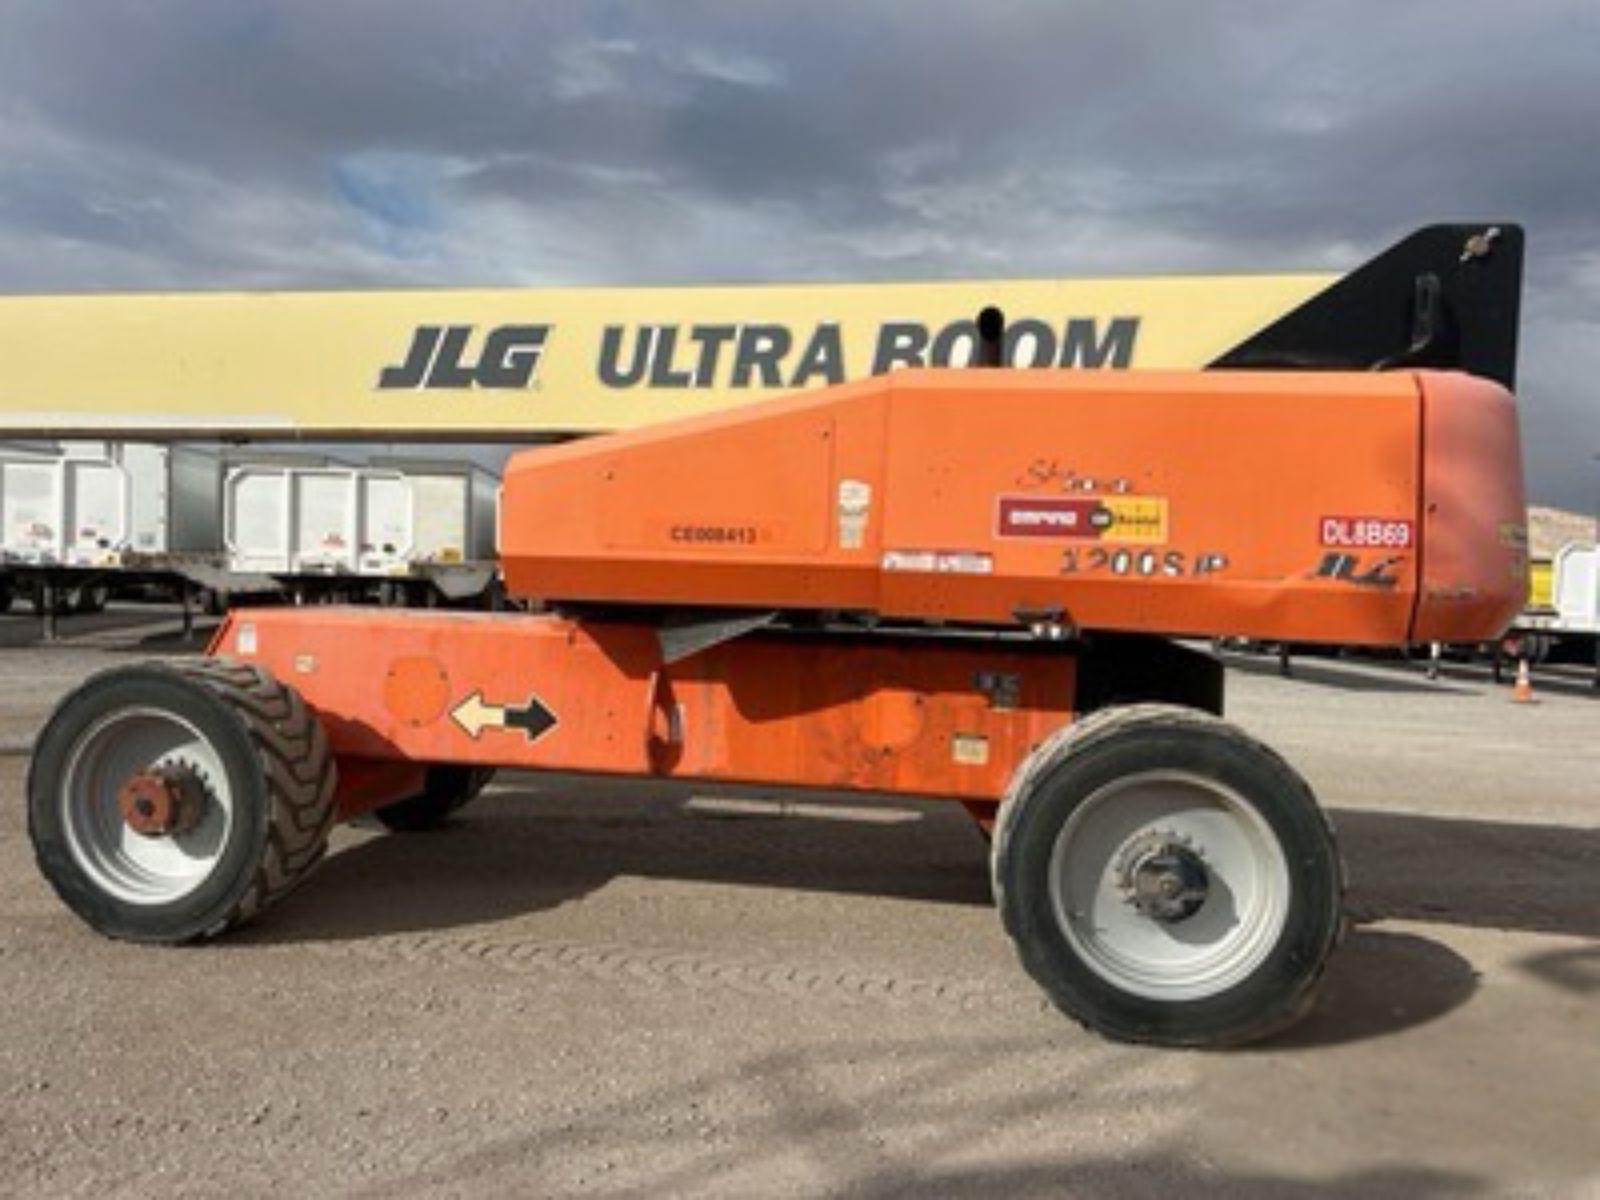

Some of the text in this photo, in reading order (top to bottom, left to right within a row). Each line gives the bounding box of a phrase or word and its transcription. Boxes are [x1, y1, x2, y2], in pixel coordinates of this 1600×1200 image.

[377, 317, 1141, 389] JLG ULTRA BOOM
